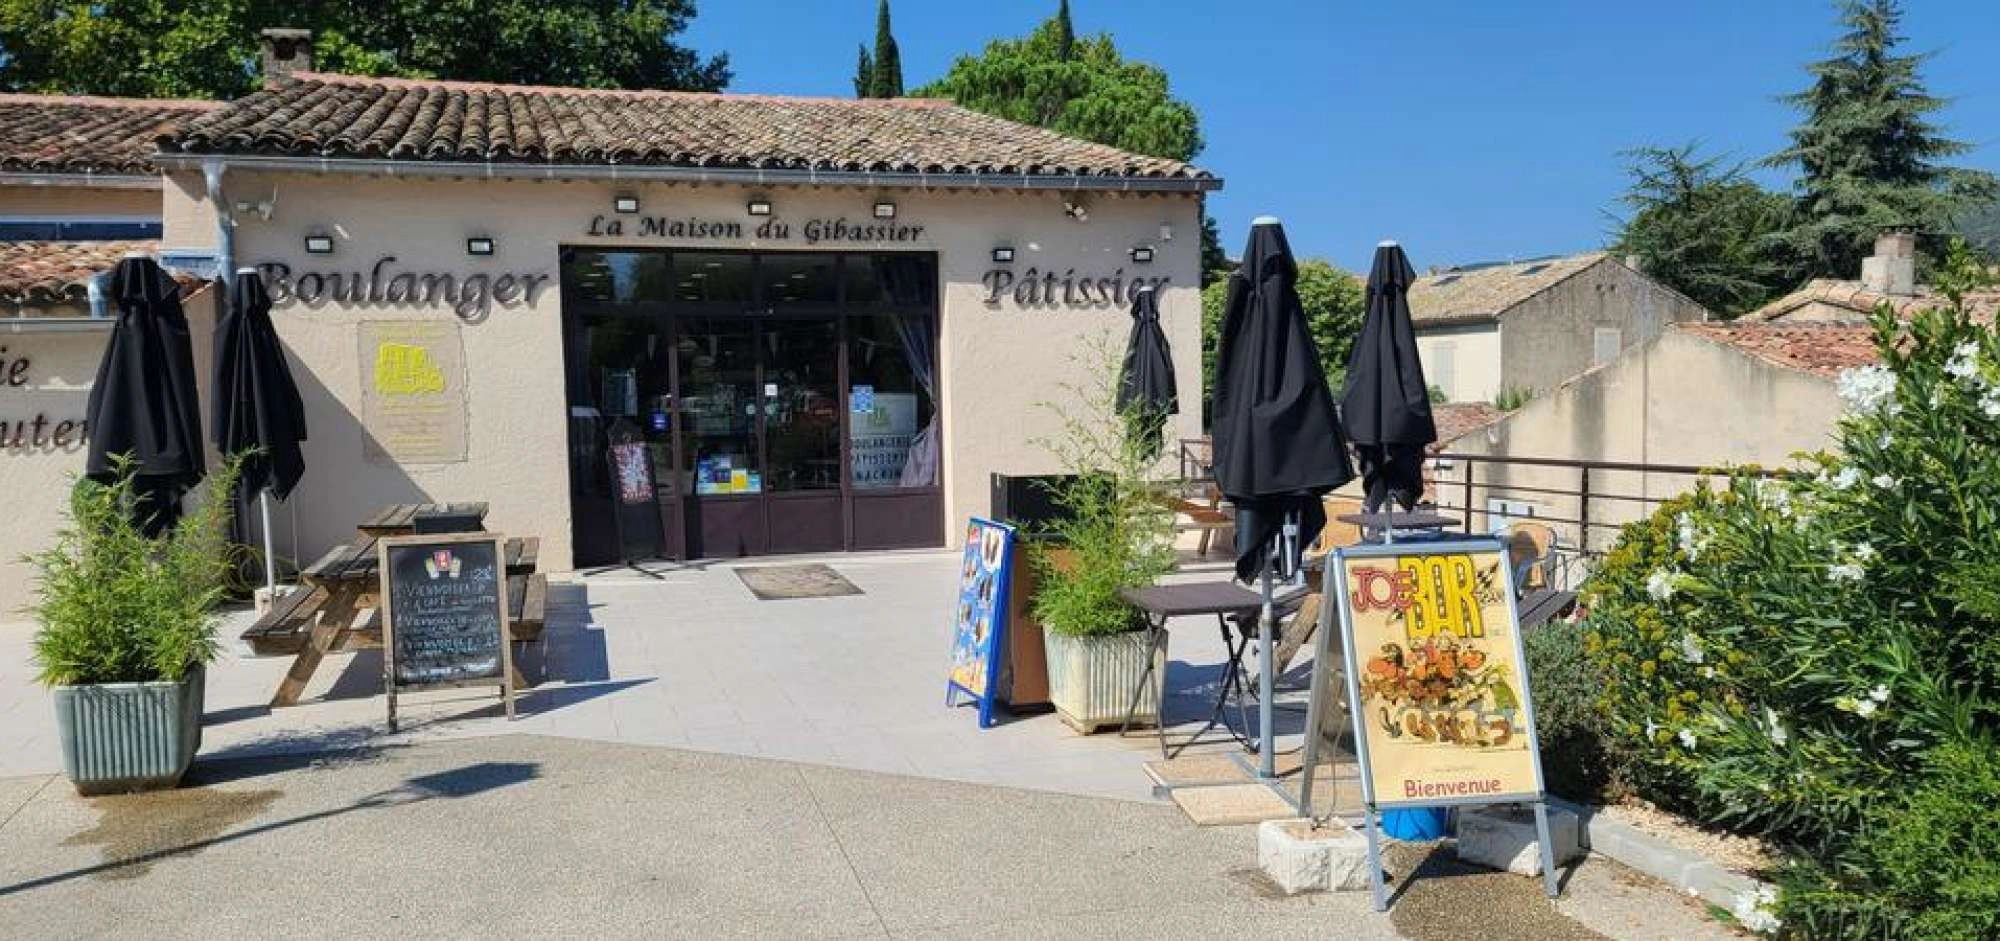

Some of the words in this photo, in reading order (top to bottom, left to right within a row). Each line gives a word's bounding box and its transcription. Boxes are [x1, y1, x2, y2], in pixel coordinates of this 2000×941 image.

[587, 215, 624, 237] La
[638, 217, 743, 239] Maison
[756, 215, 790, 239] du
[804, 217, 925, 244] Gibassier
[257, 256, 549, 320] Boulanger
[1352, 566, 1418, 612] JOE
[1398, 553, 1484, 638] BAR
[1404, 779, 1502, 798] Bienvenue
